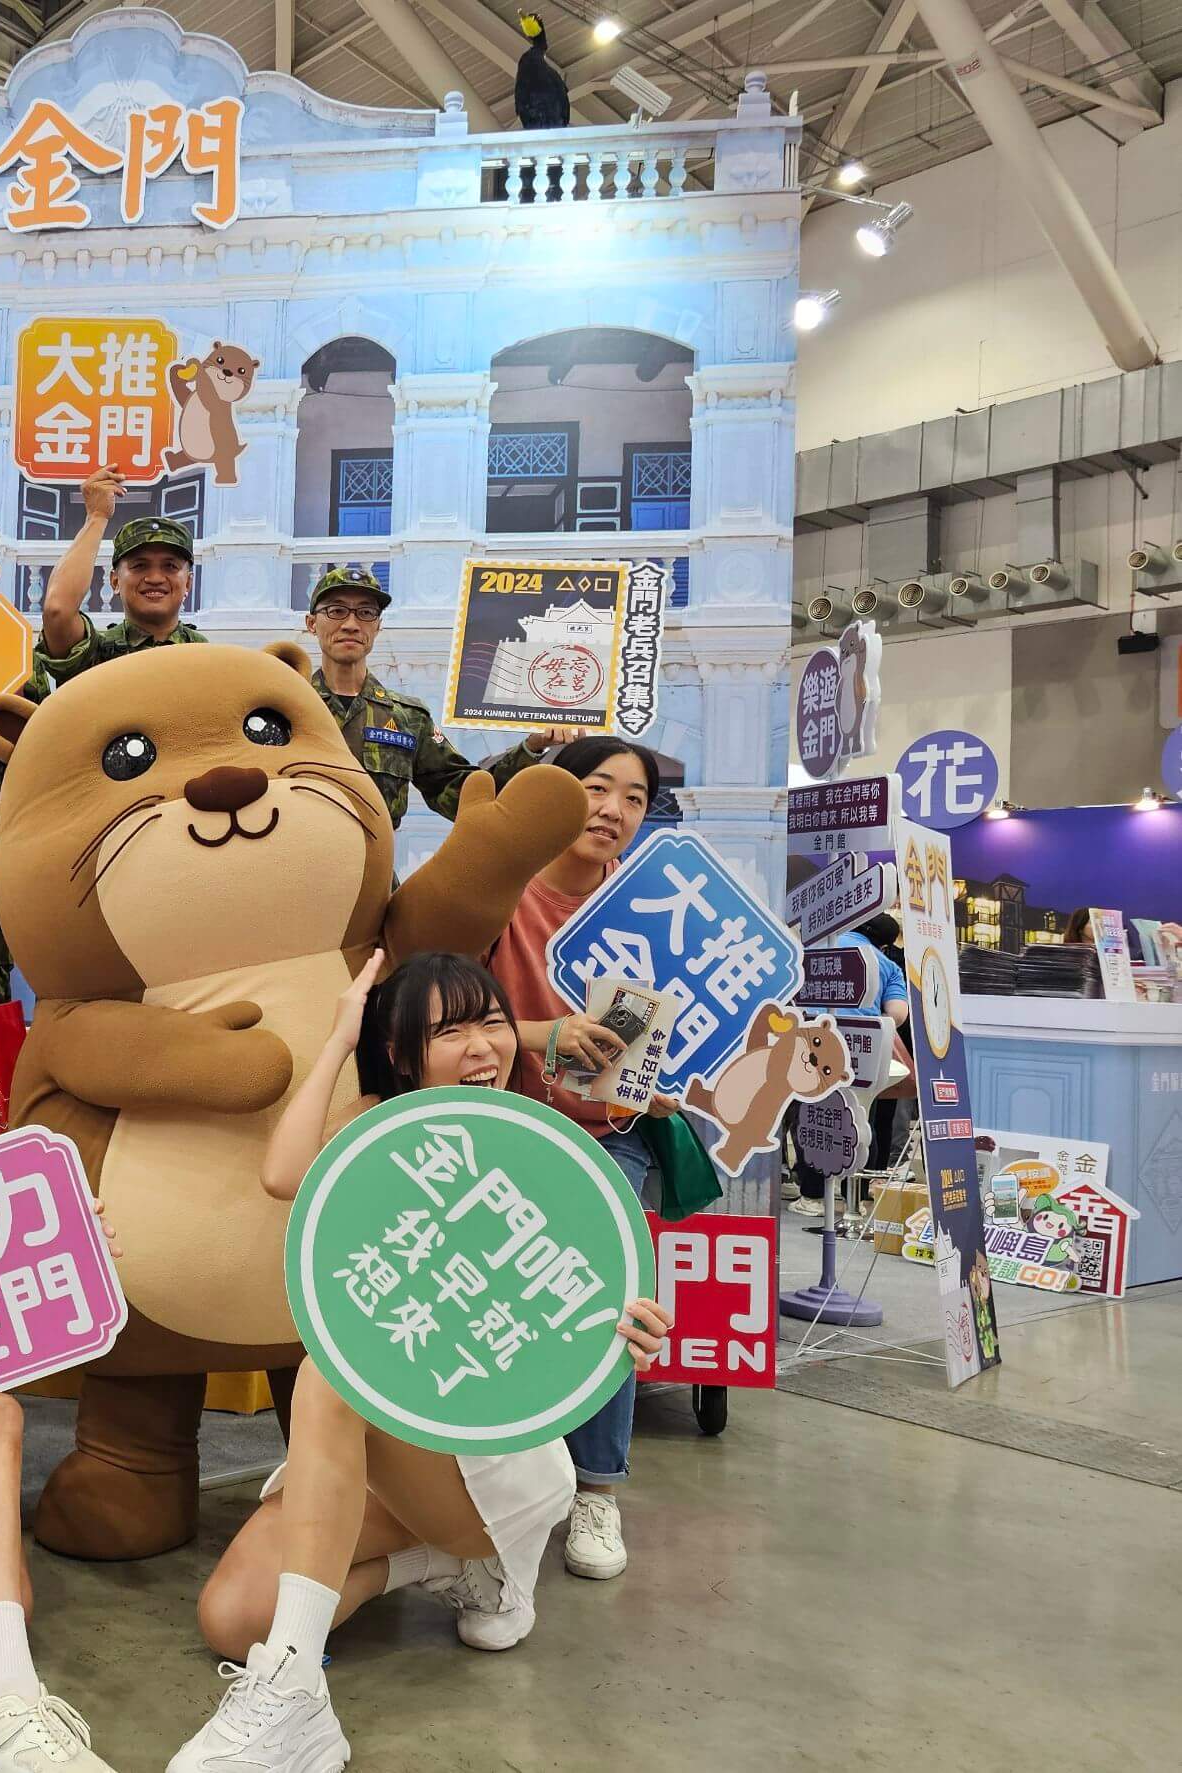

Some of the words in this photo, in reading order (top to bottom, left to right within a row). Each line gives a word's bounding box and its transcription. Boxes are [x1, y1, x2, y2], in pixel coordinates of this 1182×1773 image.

[35, 332, 160, 397] 大推
[33, 401, 153, 467] 金門
[479, 571, 543, 594] 2024
[621, 564, 664, 734] 金門老兵召集令
[802, 665, 837, 716] 樂遊
[464, 708, 483, 716] 2024
[484, 710, 516, 719] KINMEN
[518, 711, 563, 722] VETERANS
[565, 713, 601, 723] RETURN
[802, 714, 837, 761] 金門
[825, 782, 880, 805] 我在金門等你
[906, 741, 985, 818] 花
[840, 804, 878, 825] 所以我等
[813, 833, 846, 850] 金門館
[904, 838, 950, 922] 金門
[630, 863, 776, 1015] 大推
[810, 956, 842, 976] 吃喝玩樂
[616, 1068, 636, 1099] 金門
[632, 1028, 666, 1103] 老兵召集令
[807, 1104, 843, 1131] 我在金門
